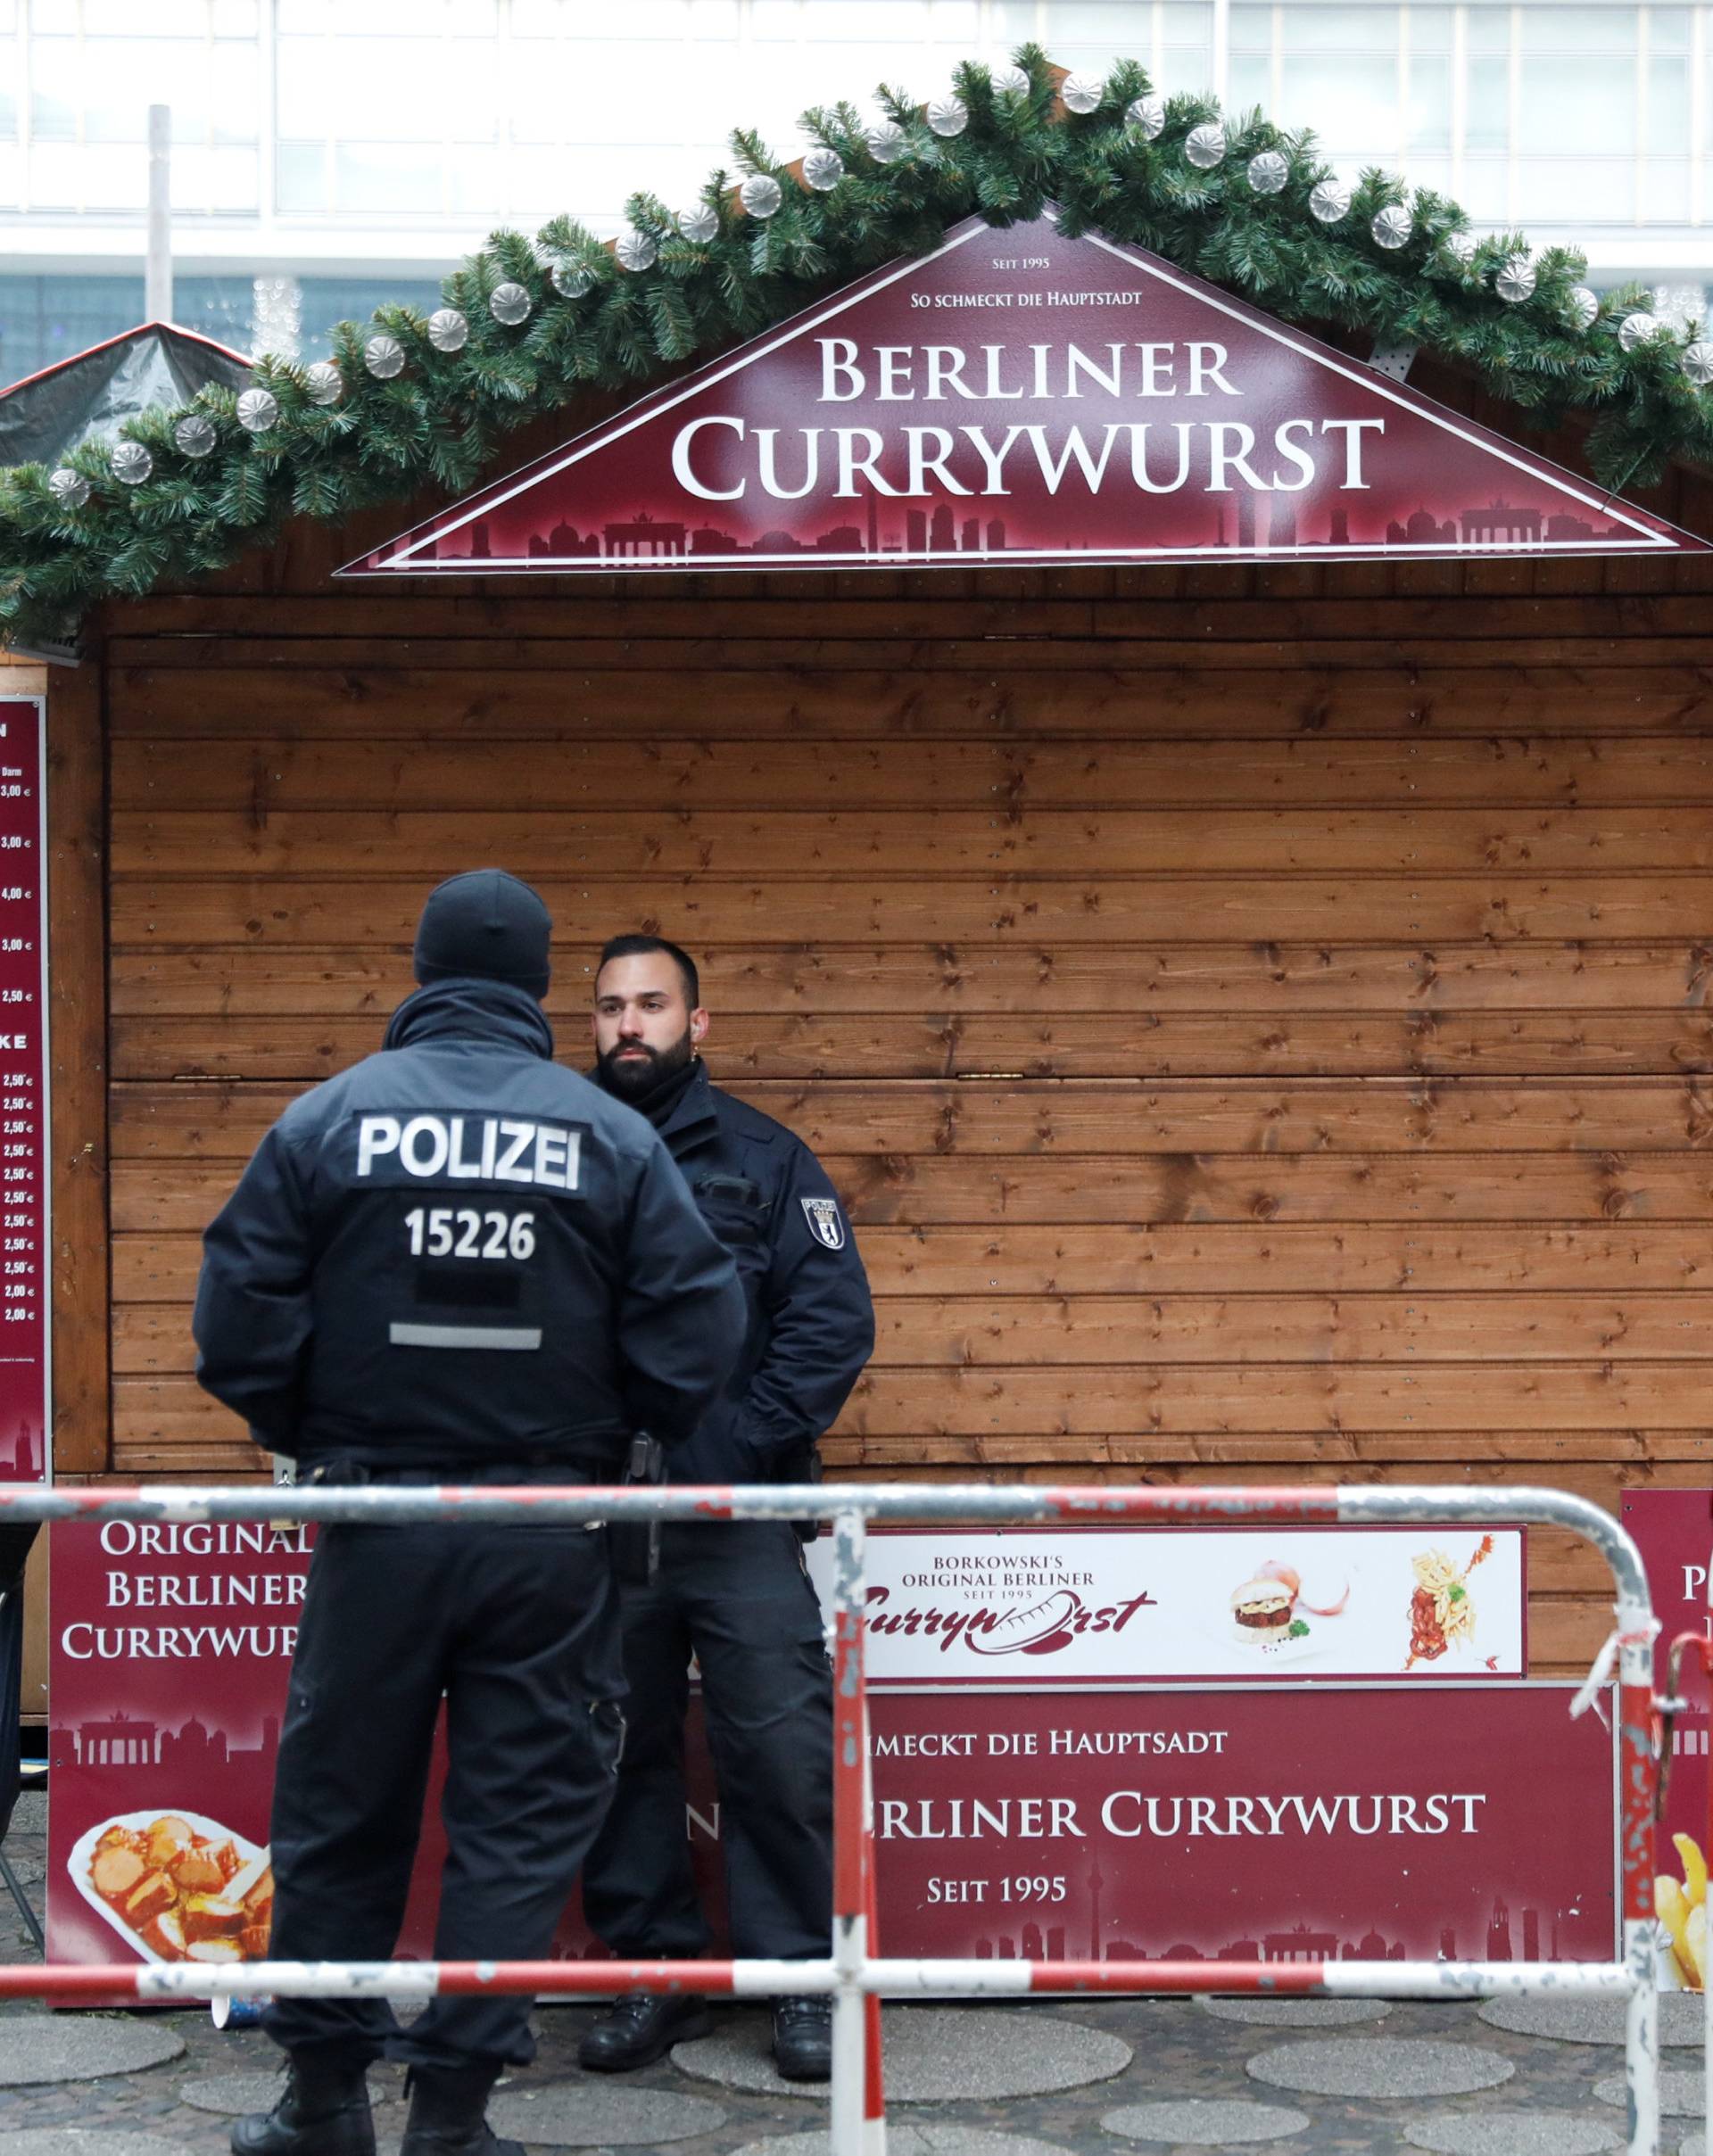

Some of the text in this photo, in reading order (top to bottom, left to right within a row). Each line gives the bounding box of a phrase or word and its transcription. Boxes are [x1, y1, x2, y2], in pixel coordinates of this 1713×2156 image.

[1022, 258, 1050, 269] 1995
[911, 292, 1142, 307] SO SCHMECKT DIE HAUPTSTADT
[814, 338, 1244, 403] BERLINER
[671, 416, 1385, 501] CURRYWURST
[1, 785, 21, 798] 3,00
[2, 837, 22, 850] 3,00
[2, 888, 22, 901] 4,00
[3, 939, 23, 953] 3,00
[3, 990, 23, 1004] 2,50
[357, 1116, 581, 1191] POLIZEI
[404, 1208, 535, 1260] 15226
[902, 1573, 1094, 1587] ORIGINAL BERLINER
[964, 1590, 1033, 1599] SEIT 1995
[62, 1623, 297, 1659] CURRYWUR
[870, 1730, 1229, 1755] MECKT DIE HAUPTSADT
[870, 1790, 1487, 1838] RLINER CURRYWURST
[927, 1876, 1067, 1903] SEIT 1995
